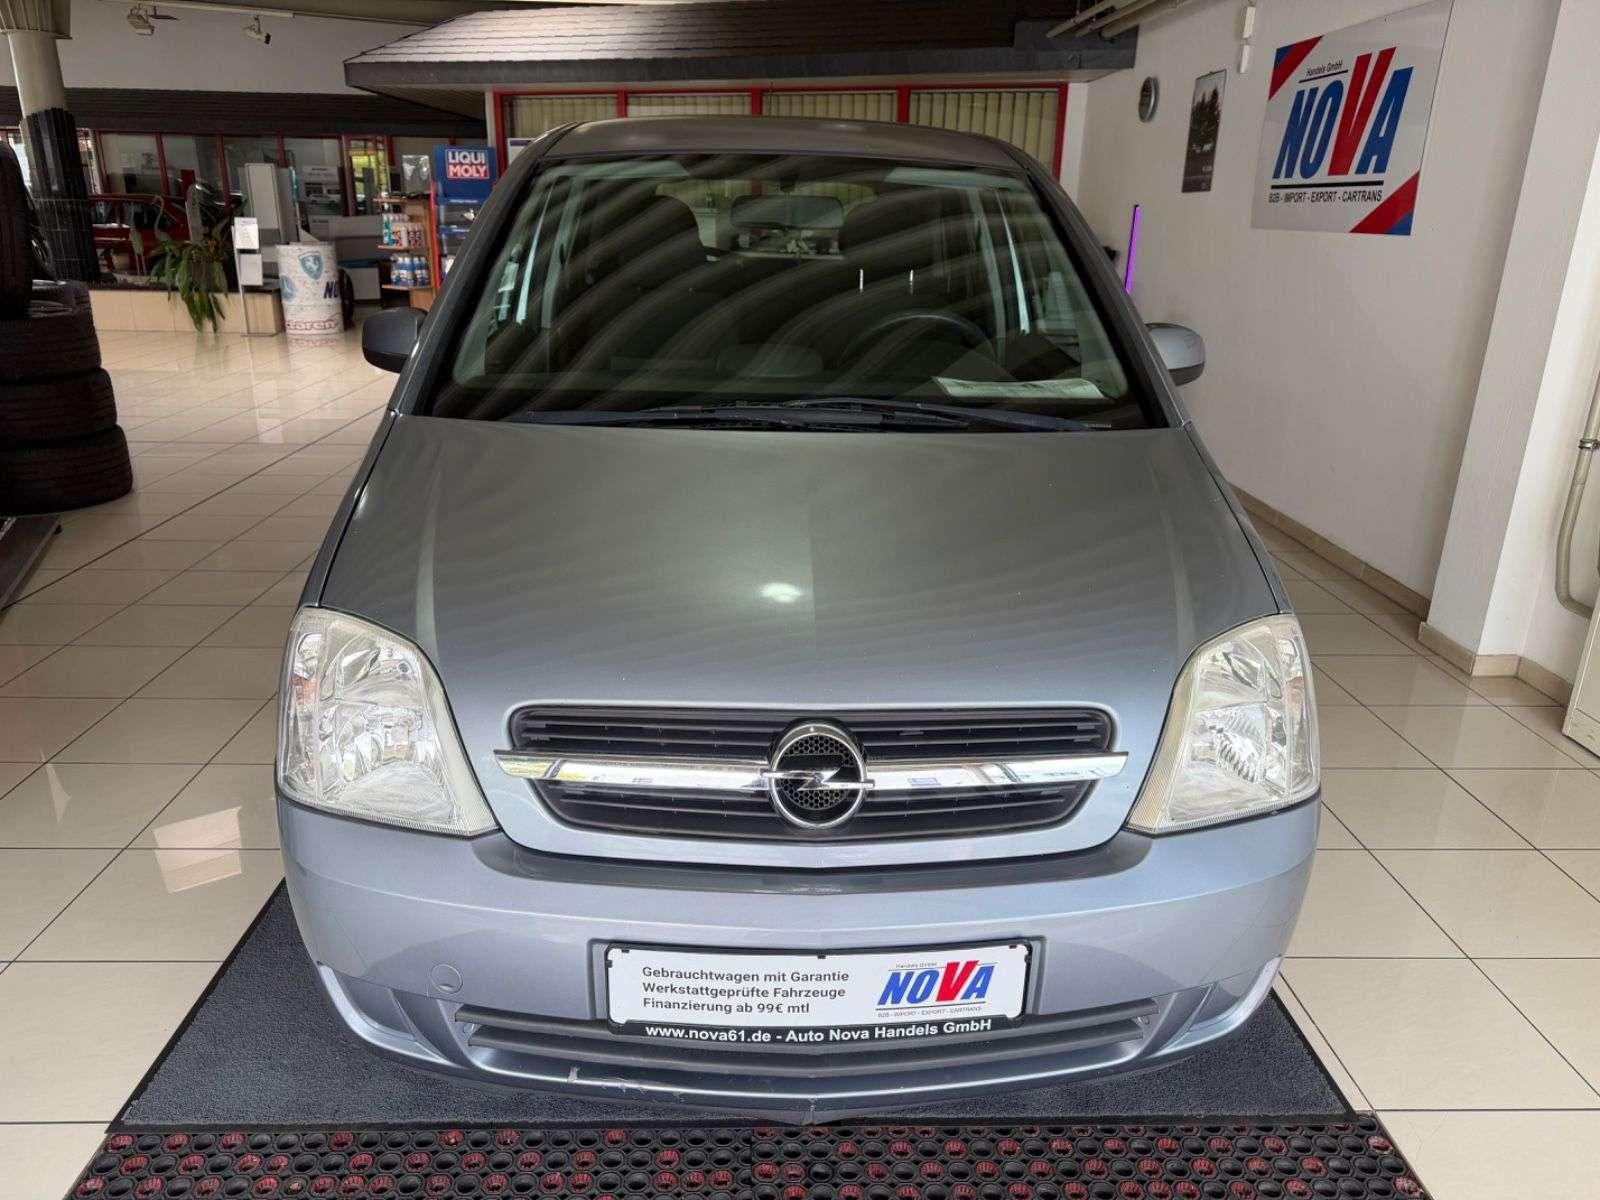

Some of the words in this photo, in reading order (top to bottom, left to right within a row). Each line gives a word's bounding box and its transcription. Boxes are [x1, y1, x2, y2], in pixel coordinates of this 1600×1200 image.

[1272, 47, 1414, 179] NOVA
[448, 151, 486, 164] LIQUI
[448, 164, 488, 178] MOLY
[1284, 192, 1306, 203] IMPORT
[1311, 191, 1337, 202] EXPORT
[1342, 189, 1383, 202] CARTRANS
[642, 967, 759, 984] Gebrauchtwagen
[763, 972, 787, 982] mit
[790, 971, 849, 982] Garantie
[877, 960, 995, 1005] NOVA
[642, 982, 769, 999] Werkstattgeprüfte
[773, 987, 846, 999] Fahrzeuge
[643, 997, 732, 1014] Finanzierung
[736, 1003, 753, 1013] ab
[757, 1003, 783, 1013] 99€
[787, 1002, 810, 1014] mtl
[645, 1026, 771, 1042] www.nova61.de
[785, 1030, 824, 1042] Auto
[829, 1029, 869, 1041] Nova
[874, 1023, 938, 1039] Handels
[943, 1019, 992, 1033] GmbH
